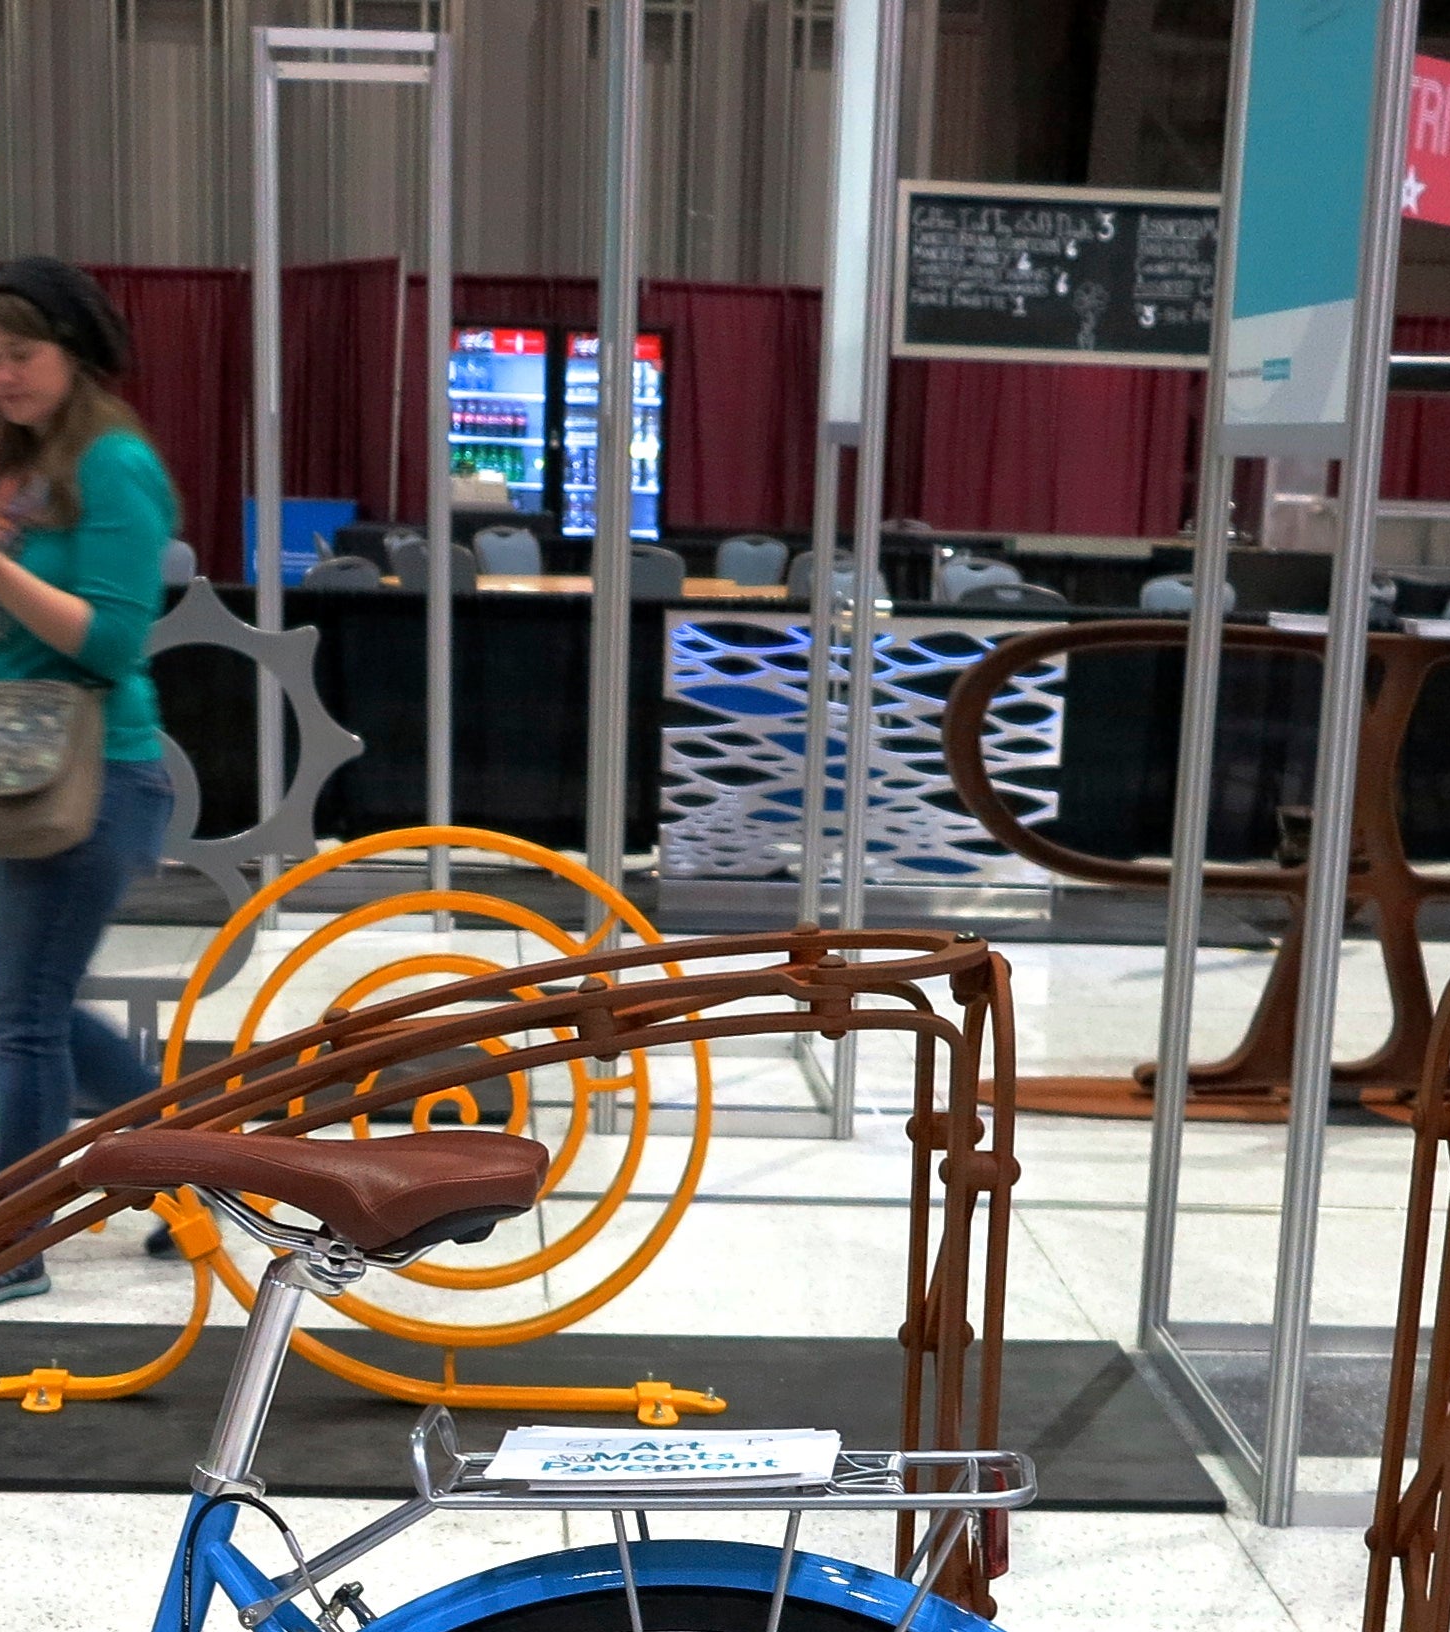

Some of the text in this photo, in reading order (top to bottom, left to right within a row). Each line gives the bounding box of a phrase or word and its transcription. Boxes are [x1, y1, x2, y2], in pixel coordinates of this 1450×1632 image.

[629, 1441, 705, 1451] Art
[594, 1452, 736, 1462] Meets
[541, 1459, 781, 1472] Pavement
